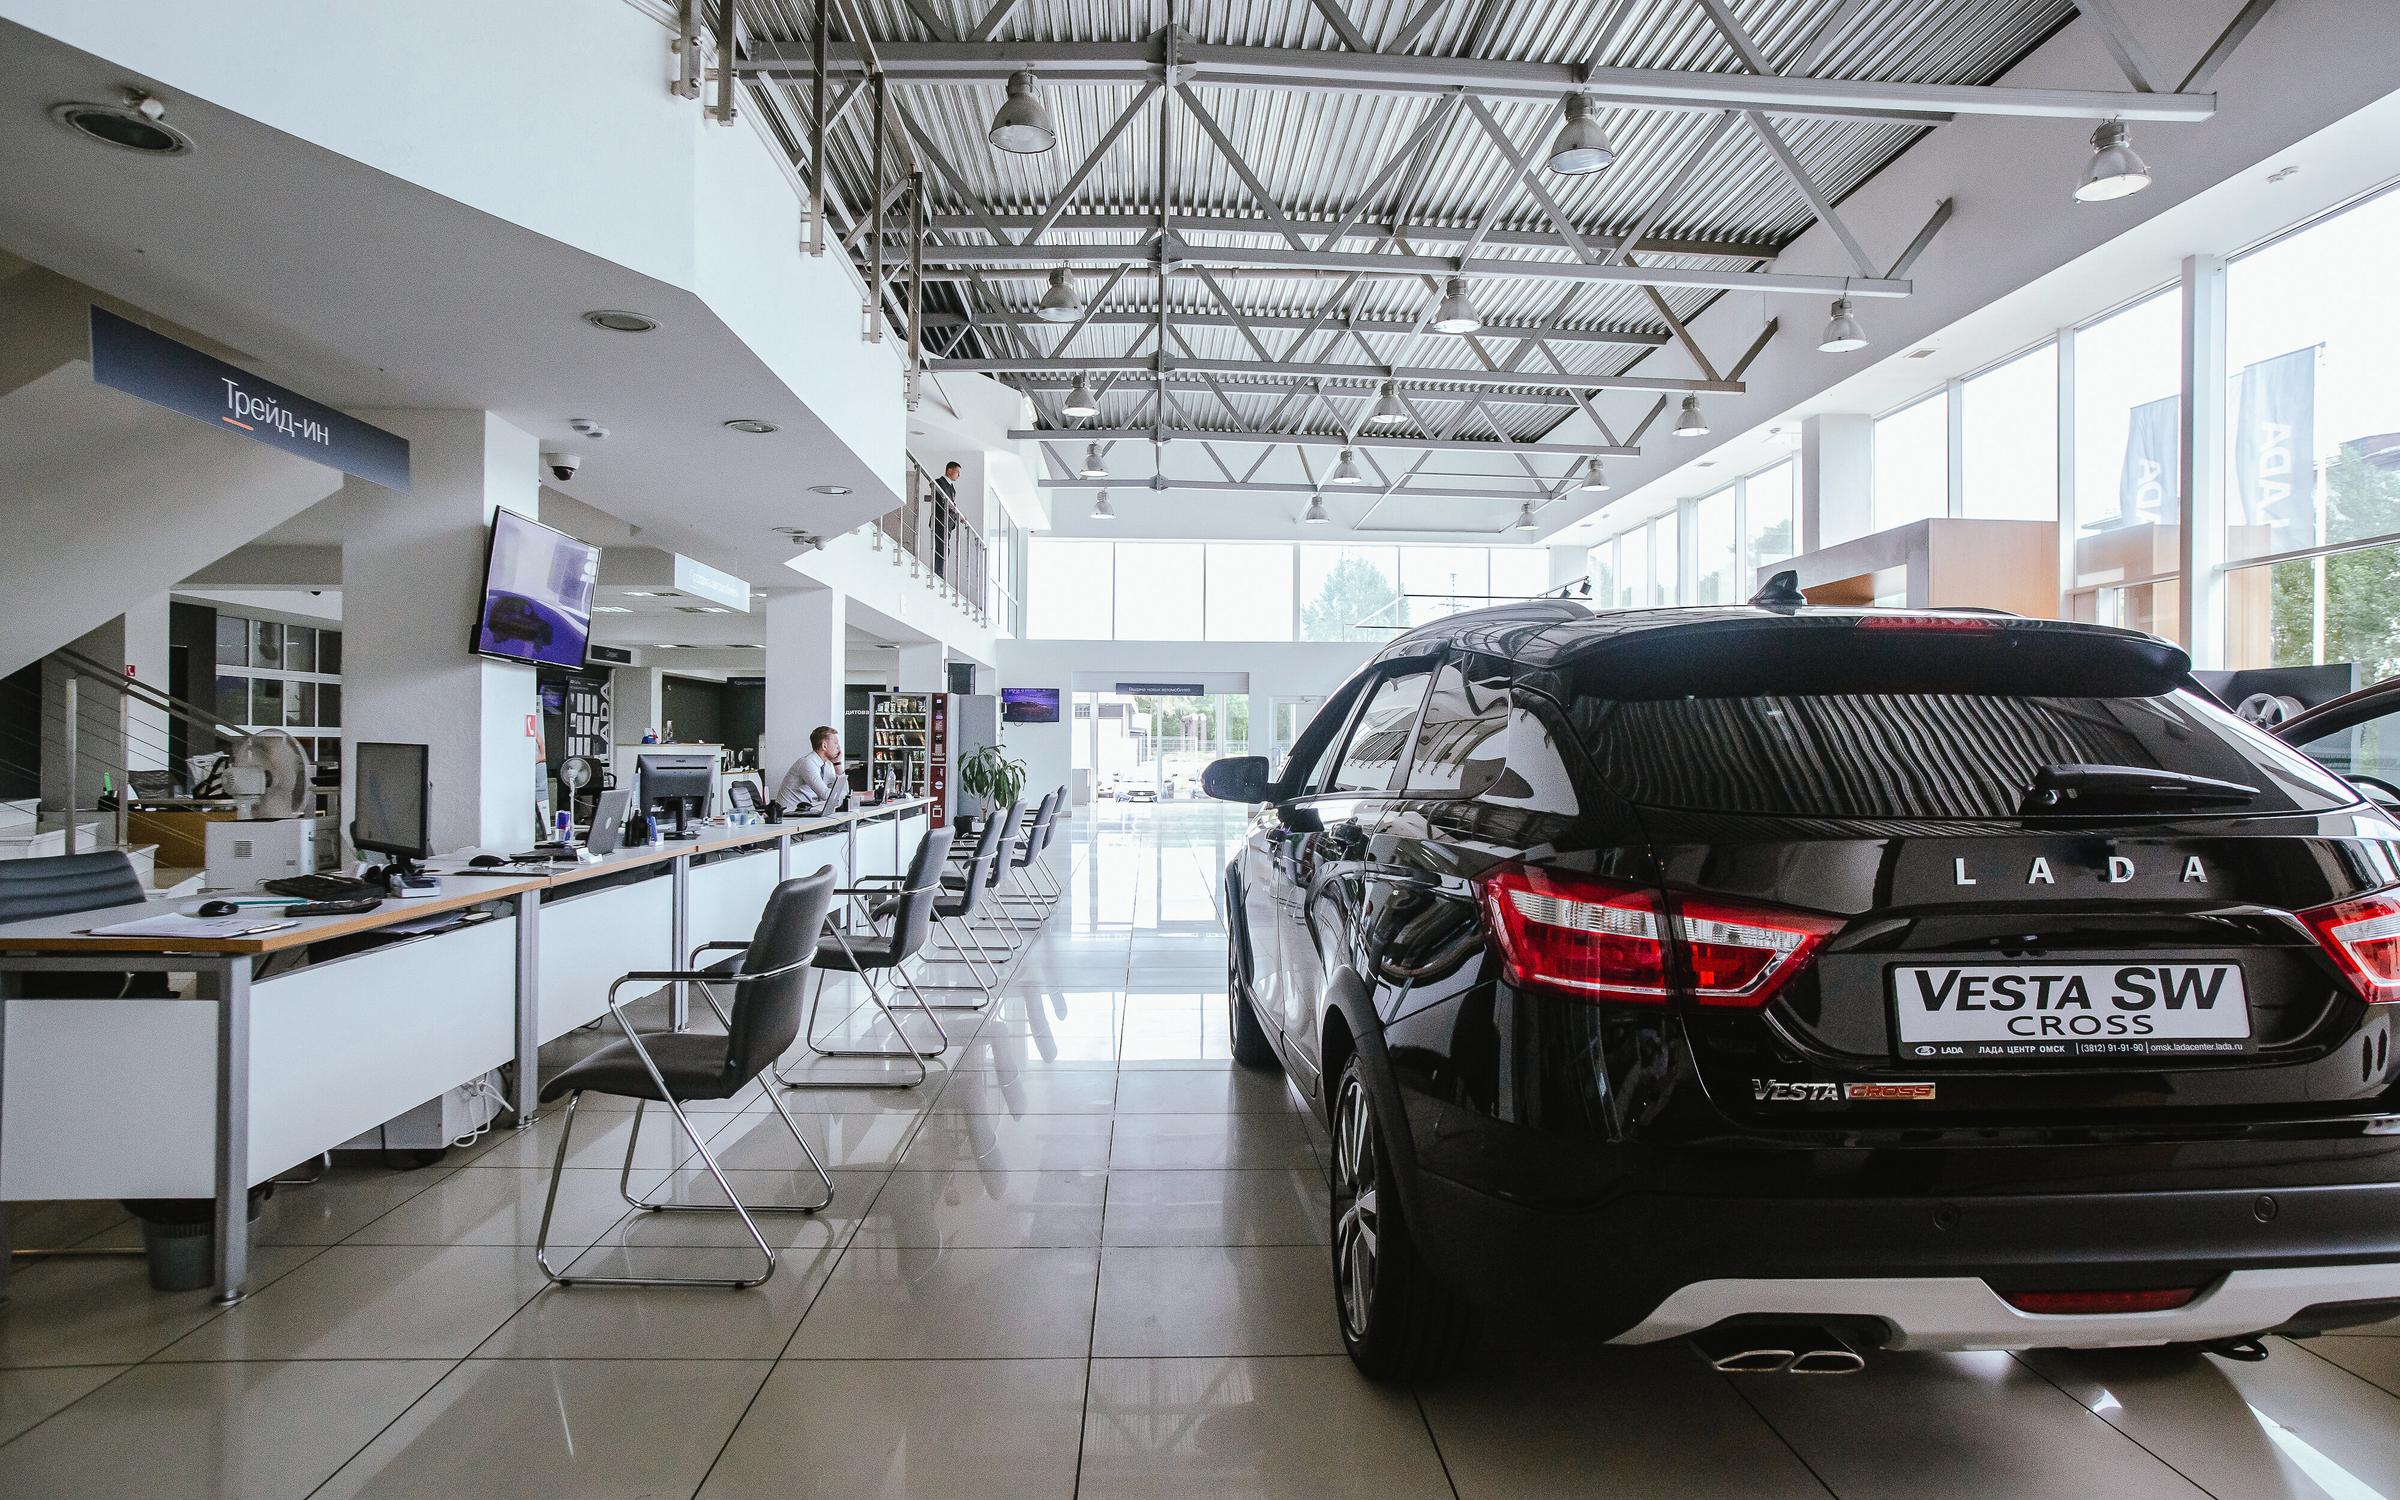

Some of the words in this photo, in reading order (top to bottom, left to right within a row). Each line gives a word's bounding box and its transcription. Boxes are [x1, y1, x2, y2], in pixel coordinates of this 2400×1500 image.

[221, 377, 329, 445] Трейд-ин
[1955, 856, 2208, 885] LADA
[1914, 969, 2092, 1011] VESTA
[2111, 966, 2228, 1011] SW
[2007, 1014, 2154, 1037] CROSS
[1941, 1046, 1964, 1055] LADA
[1978, 1046, 2004, 1055] ЛАДА
[2007, 1046, 2036, 1055] ЦЕНТР
[2039, 1045, 2065, 1054] ОМСК
[2080, 1042, 2106, 1054] (3812)
[2108, 1043, 2144, 1053] 91-91-90
[2150, 1042, 2243, 1052] omsk.ladacenter.lada.ru
[1752, 1079, 1839, 1101] VESTA
[1851, 1085, 1931, 1098] CROSS
